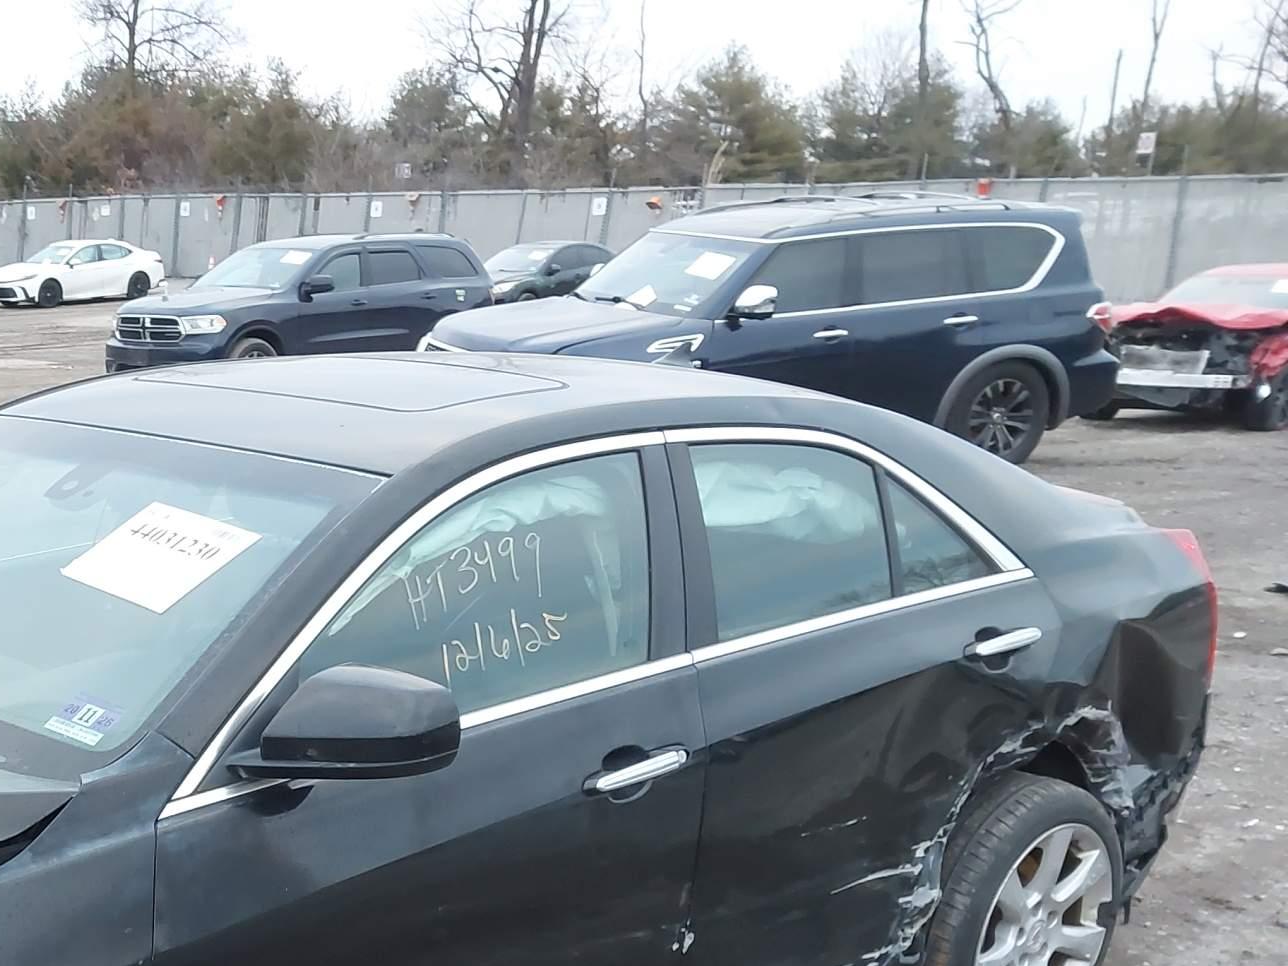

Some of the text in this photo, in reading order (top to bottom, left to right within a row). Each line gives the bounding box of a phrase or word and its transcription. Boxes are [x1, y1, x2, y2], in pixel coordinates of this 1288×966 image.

[130, 523, 221, 560] 44031230
[442, 608, 567, 691] 12/6/25
[77, 707, 98, 724] 11
